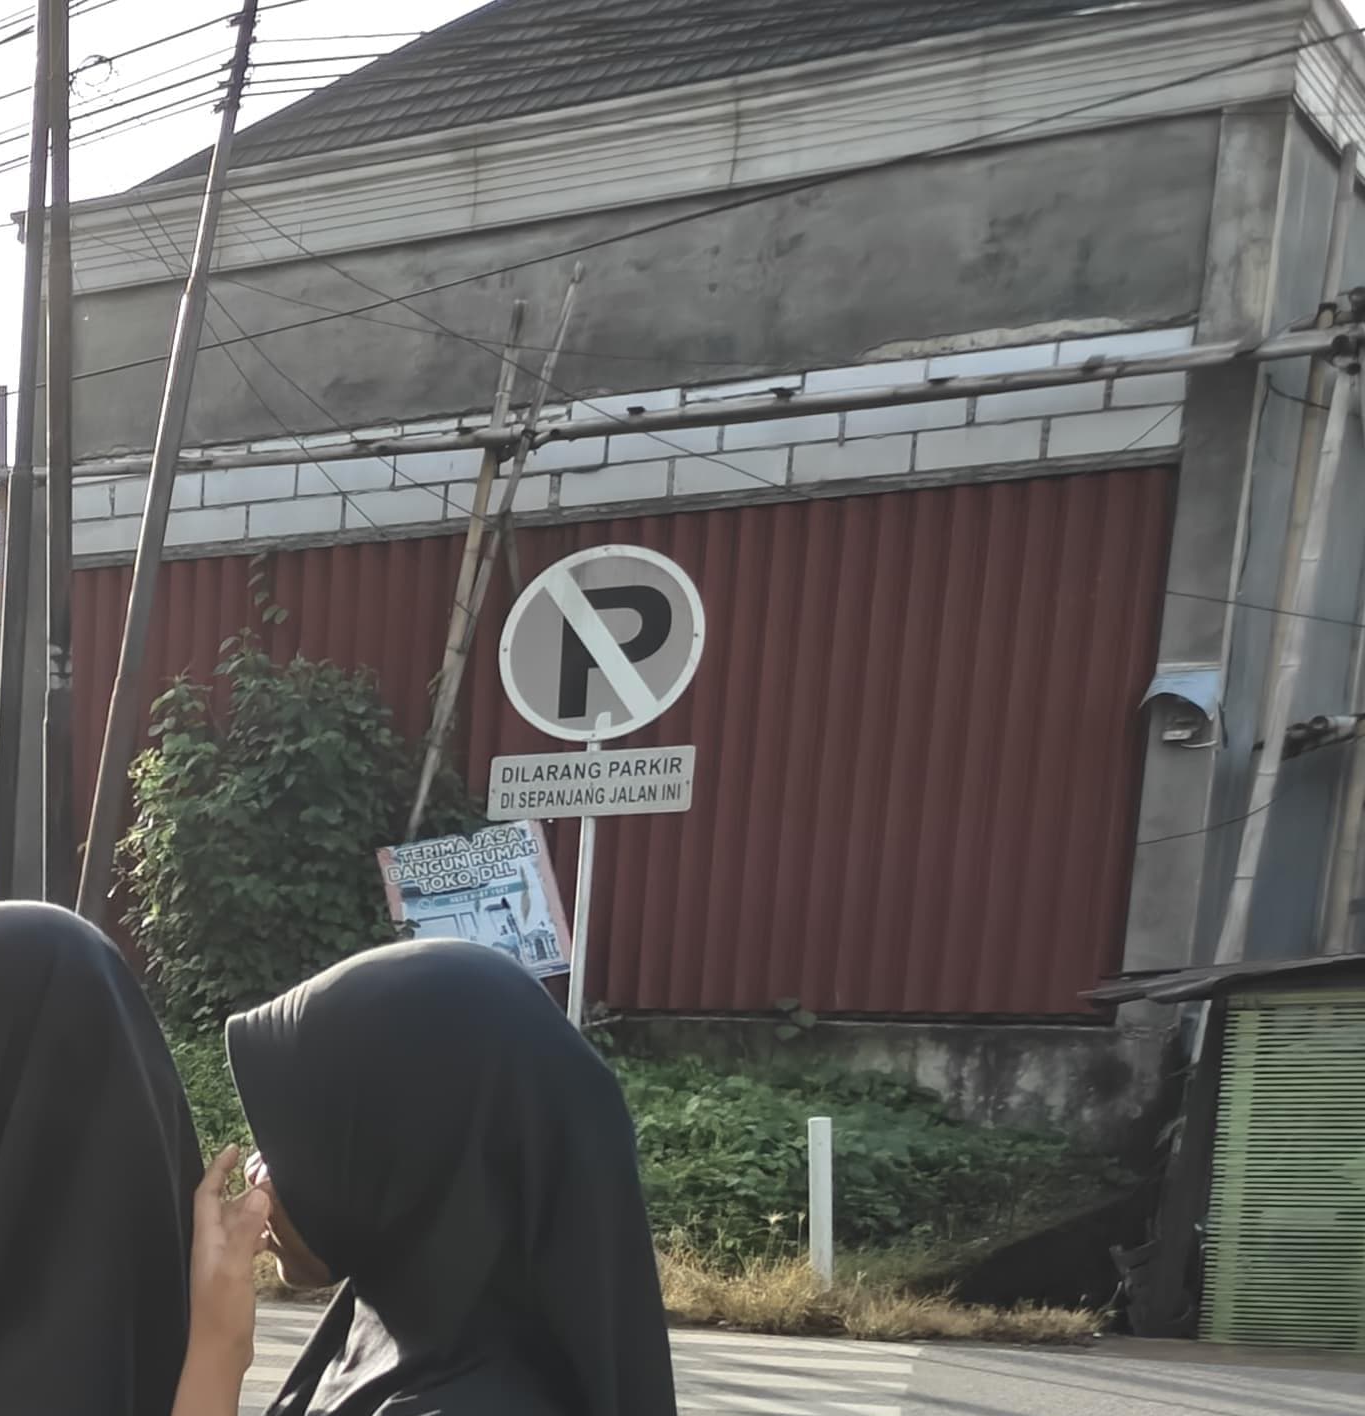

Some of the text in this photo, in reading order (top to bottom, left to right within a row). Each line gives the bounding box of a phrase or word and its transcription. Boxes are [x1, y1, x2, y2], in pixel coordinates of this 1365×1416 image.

[501, 756, 683, 784] DILARANG PARKIR
[500, 783, 681, 809] DI SEPANJANG JALAN INI
[387, 840, 539, 882] BANGUN RUMAH
[398, 827, 521, 864] TERIMA JASA
[419, 872, 479, 895] TOKO,
[480, 861, 517, 883] DLL
